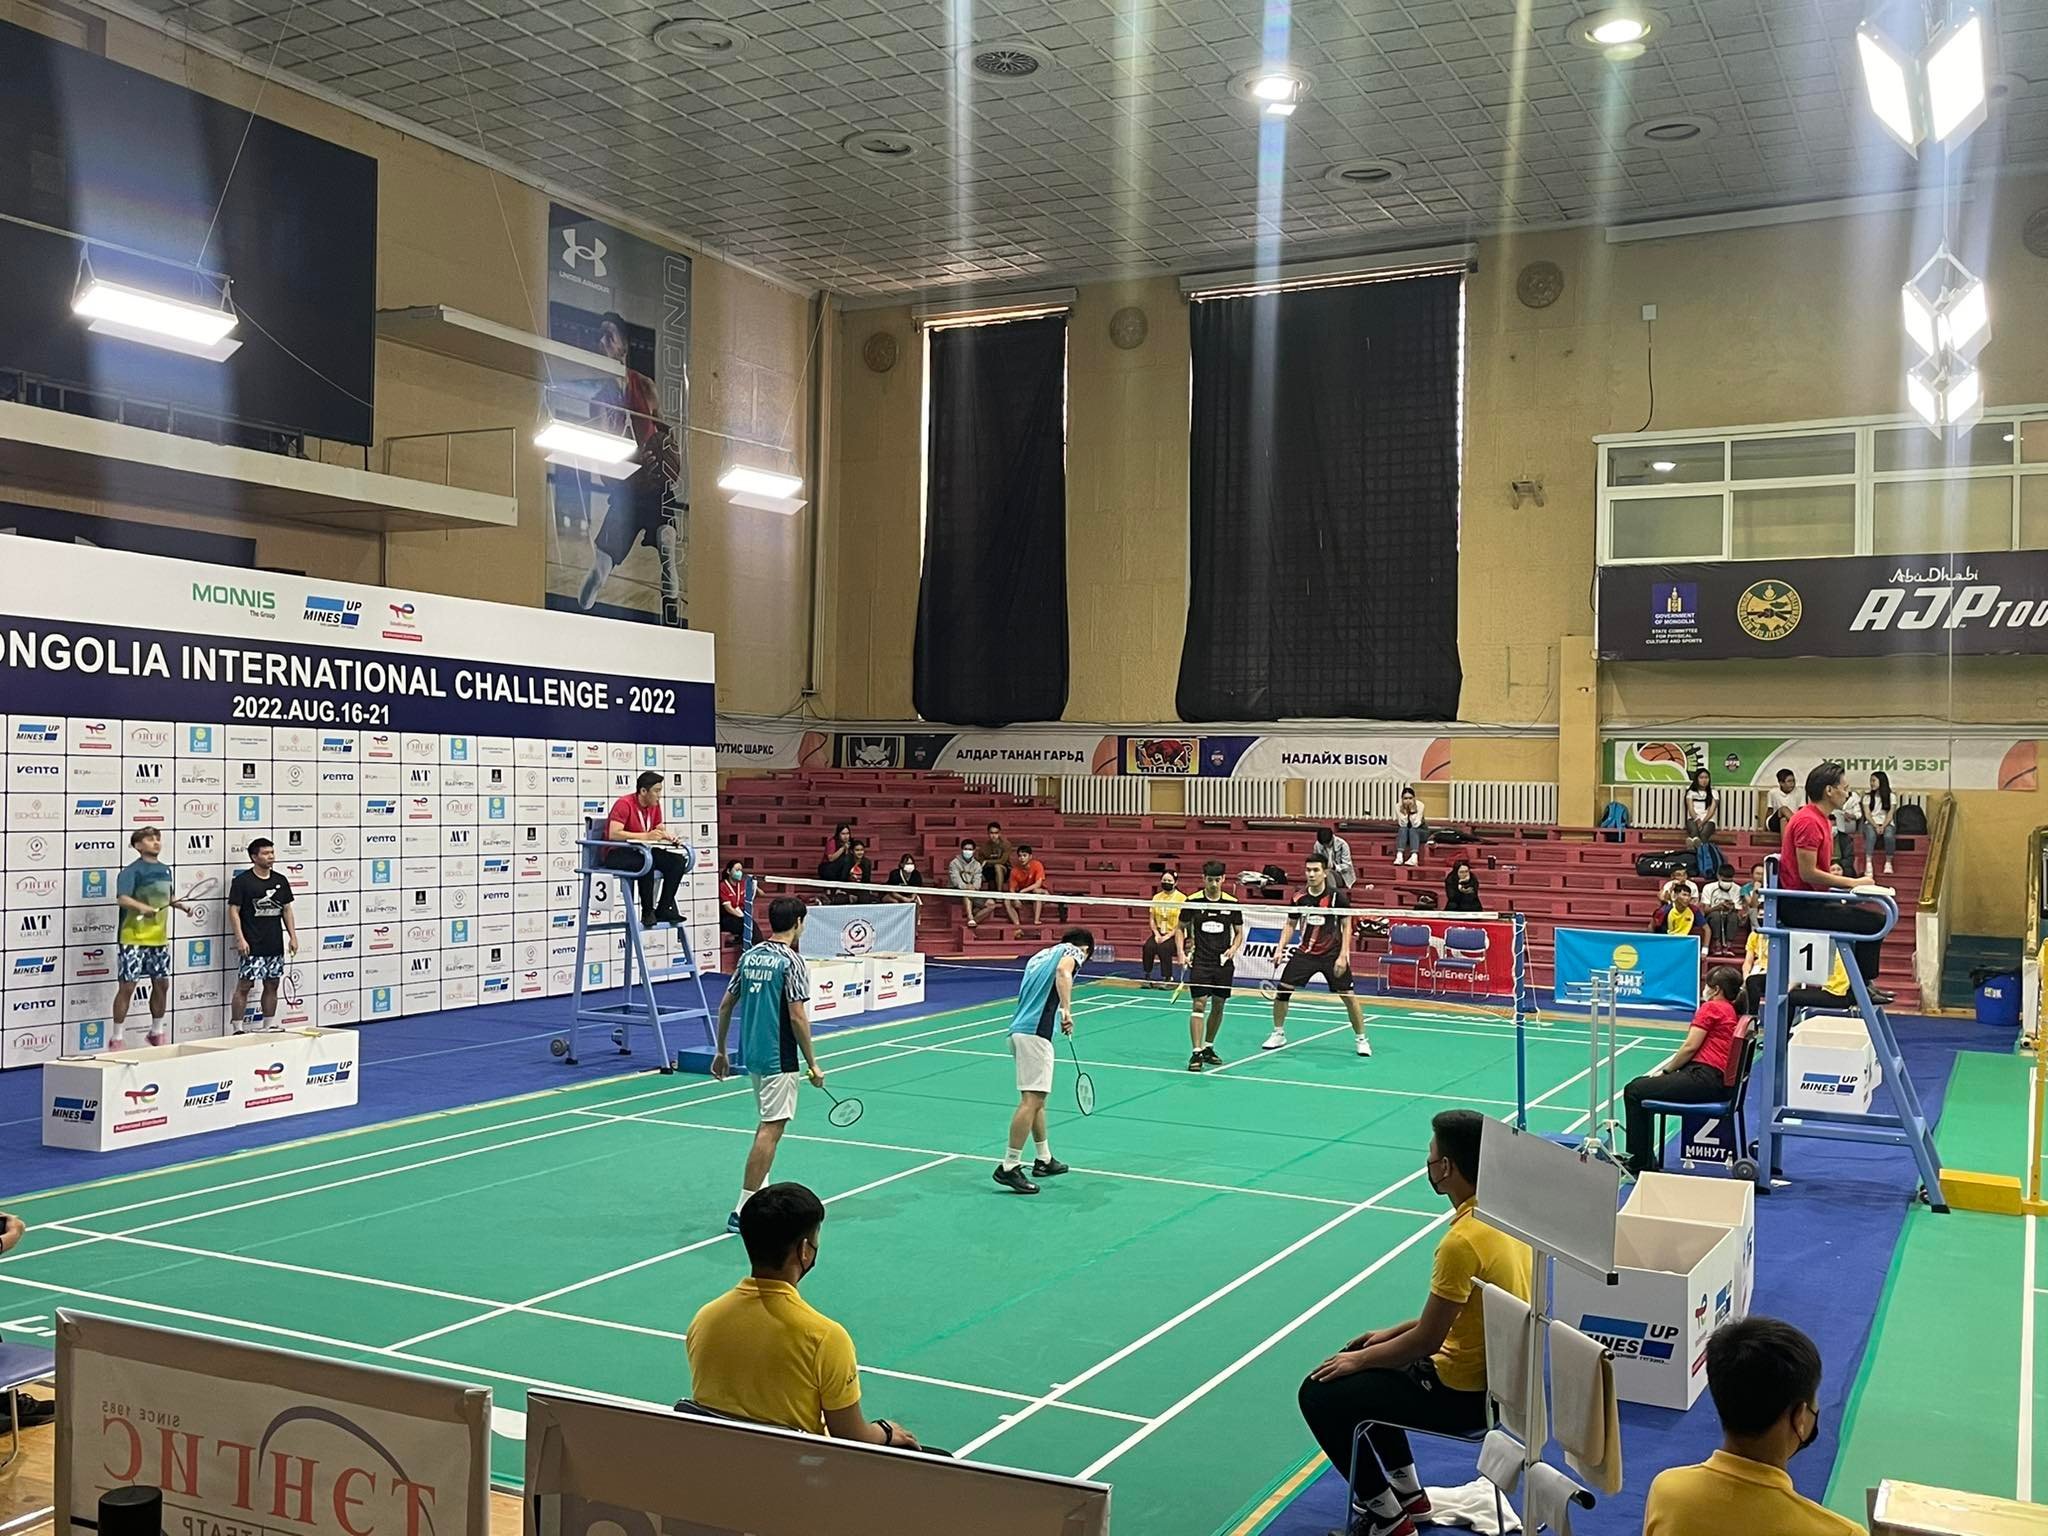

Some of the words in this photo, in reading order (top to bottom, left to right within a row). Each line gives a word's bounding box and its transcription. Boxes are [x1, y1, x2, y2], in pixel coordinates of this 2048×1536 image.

[1889, 568, 1927, 583] Abu
[1928, 565, 1979, 582] Dhabi
[346, 601, 362, 611] UP
[1849, 585, 2001, 631] AJP
[250, 609, 260, 617] The
[260, 611, 276, 620] Group
[303, 610, 340, 624] MINES
[0, 630, 170, 677] NGOLIA
[182, 646, 446, 697] INTERNATIONAL
[455, 670, 608, 709] CHALLENGE
[629, 686, 675, 714] 2022
[233, 696, 389, 724] 2022.AUG.16-21
[744, 744, 774, 755] ШАРКС
[956, 750, 998, 760] АЛДАР
[1000, 750, 1041, 761] ТАНАН
[1044, 751, 1084, 762] ГАРЬД
[1282, 751, 1342, 765] НАЛАЙХ
[1344, 753, 1388, 766] BISON
[1902, 759, 1951, 771] ЭБЭГ
[595, 881, 607, 901] 3
[1799, 943, 1814, 971] 1
[13, 966, 40, 974] MINES
[339, 1061, 352, 1070] UP
[220, 1080, 233, 1090] UP
[306, 1073, 335, 1085] MINES
[1841, 1075, 1858, 1083] UP
[1800, 1082, 1835, 1092] MINES
[85, 1100, 98, 1109] UP
[184, 1094, 214, 1108] MINES
[52, 1108, 80, 1119] MINES
[1686, 1145, 1726, 1159] МИНУТ
[1650, 1324, 1679, 1339] UP
[1587, 1334, 1640, 1353] NES
